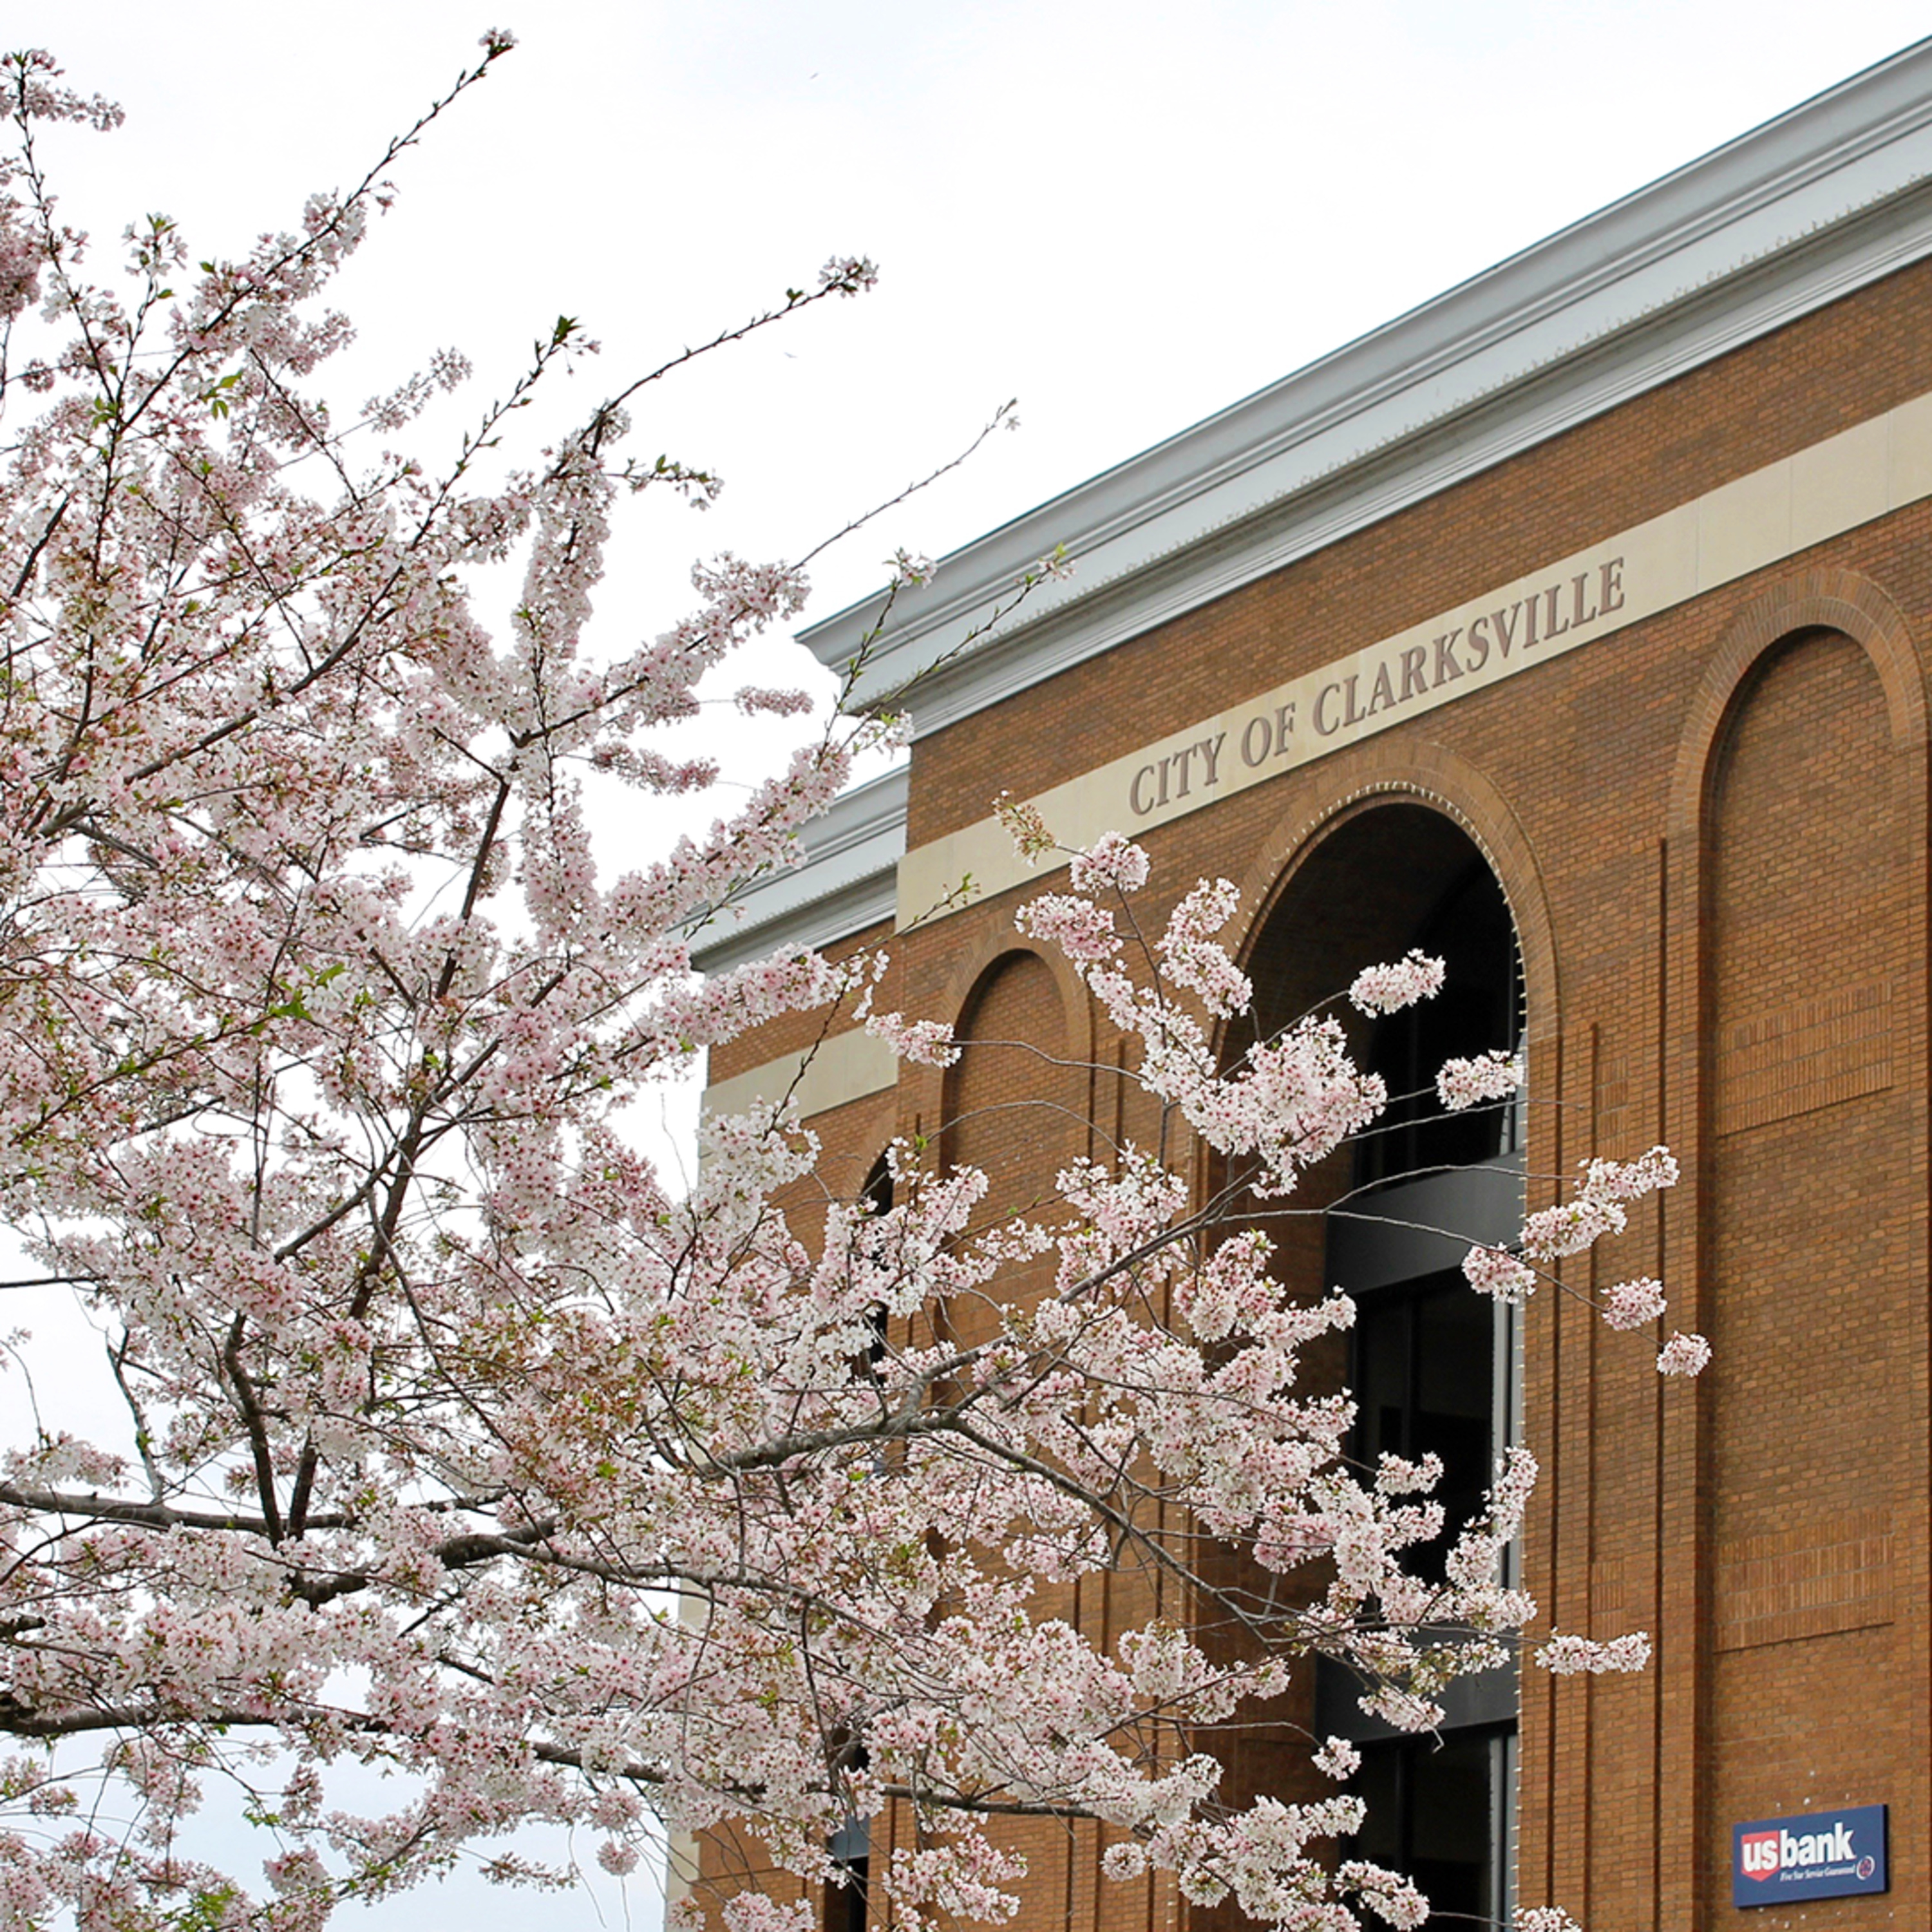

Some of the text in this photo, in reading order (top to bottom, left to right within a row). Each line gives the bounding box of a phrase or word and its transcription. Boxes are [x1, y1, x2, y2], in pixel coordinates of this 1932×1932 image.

[1129, 556, 1625, 816] CITY OF CLARKSVILLE
